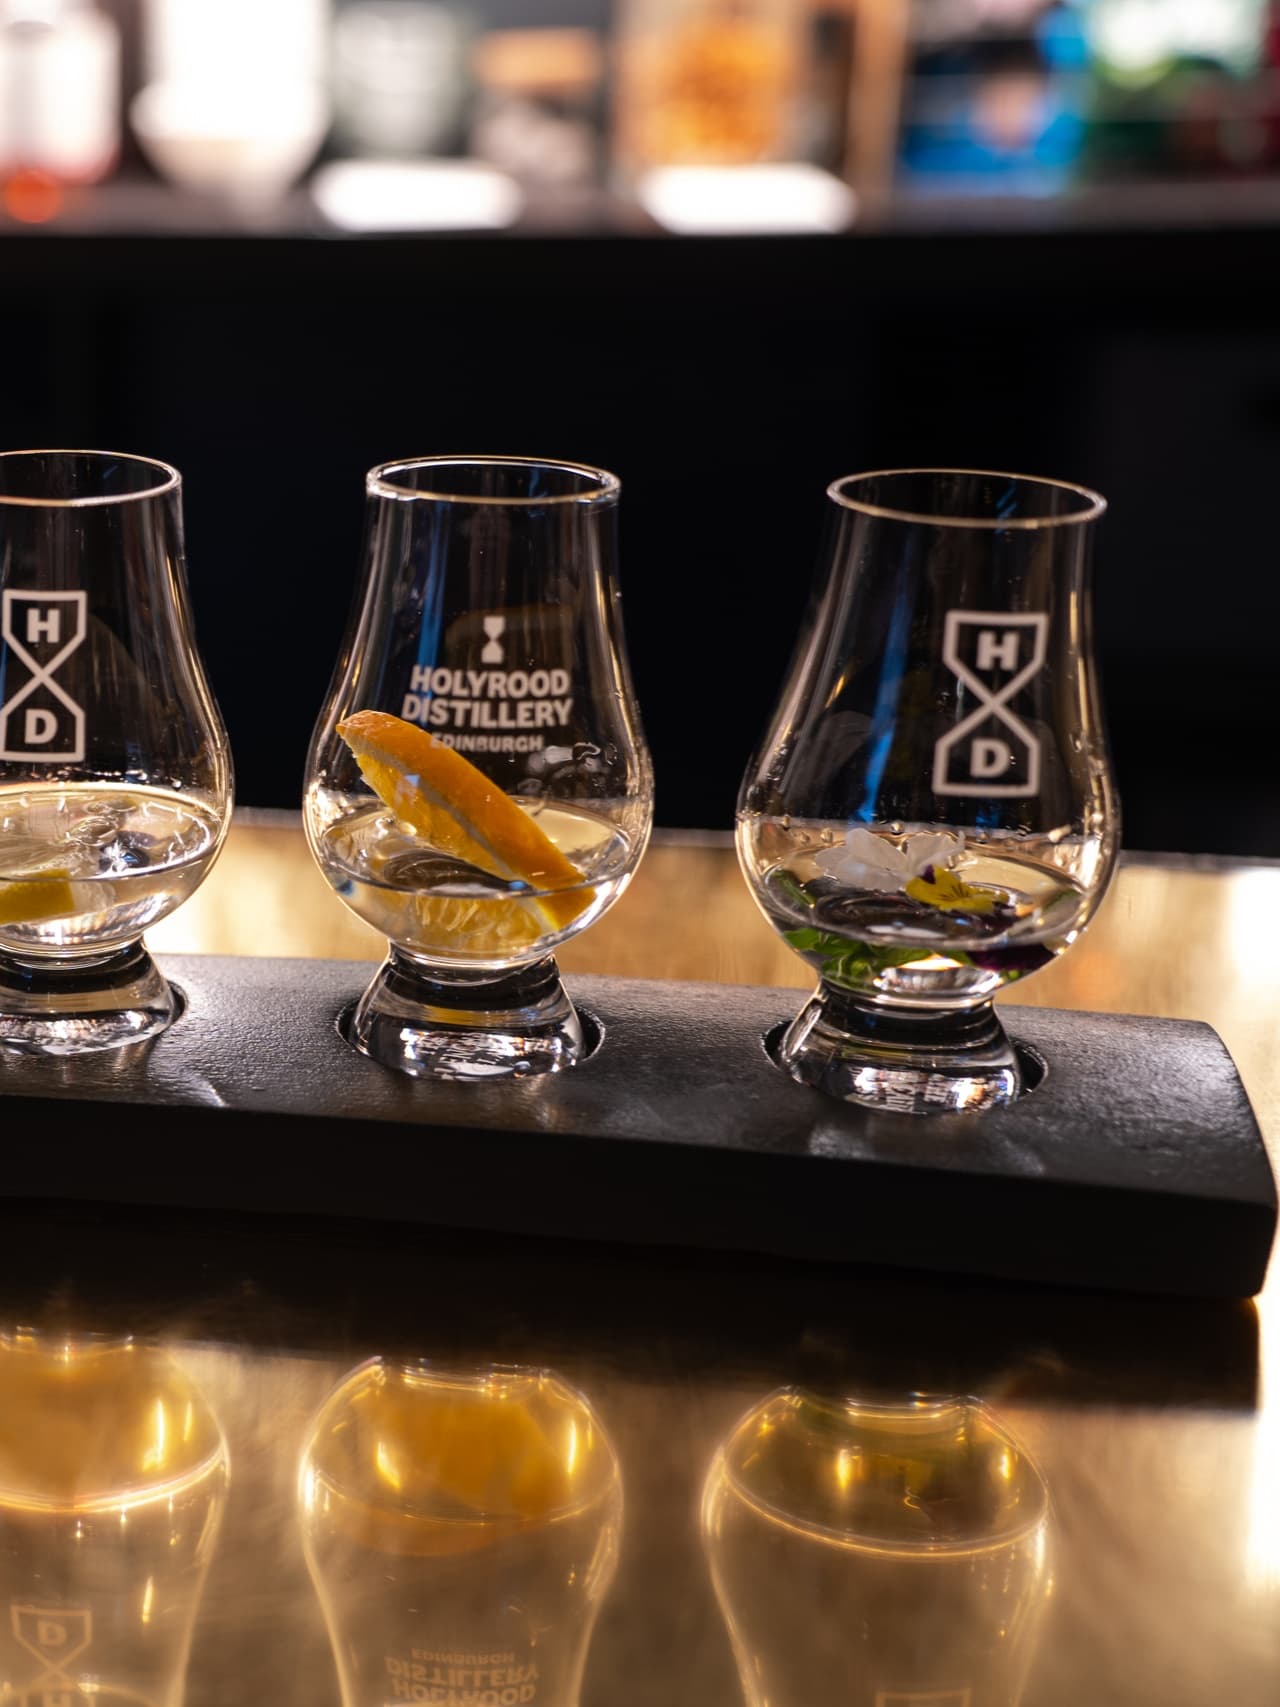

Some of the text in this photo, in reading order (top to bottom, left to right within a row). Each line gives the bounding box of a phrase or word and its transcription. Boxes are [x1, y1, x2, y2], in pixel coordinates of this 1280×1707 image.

[26, 607, 61, 644] H
[975, 629, 1020, 671] H
[409, 664, 570, 698] HOLYROOD
[23, 708, 59, 746] D
[400, 693, 574, 729] DISTILLERY
[430, 731, 545, 753] EDINBURGH
[970, 737, 1011, 778] D
